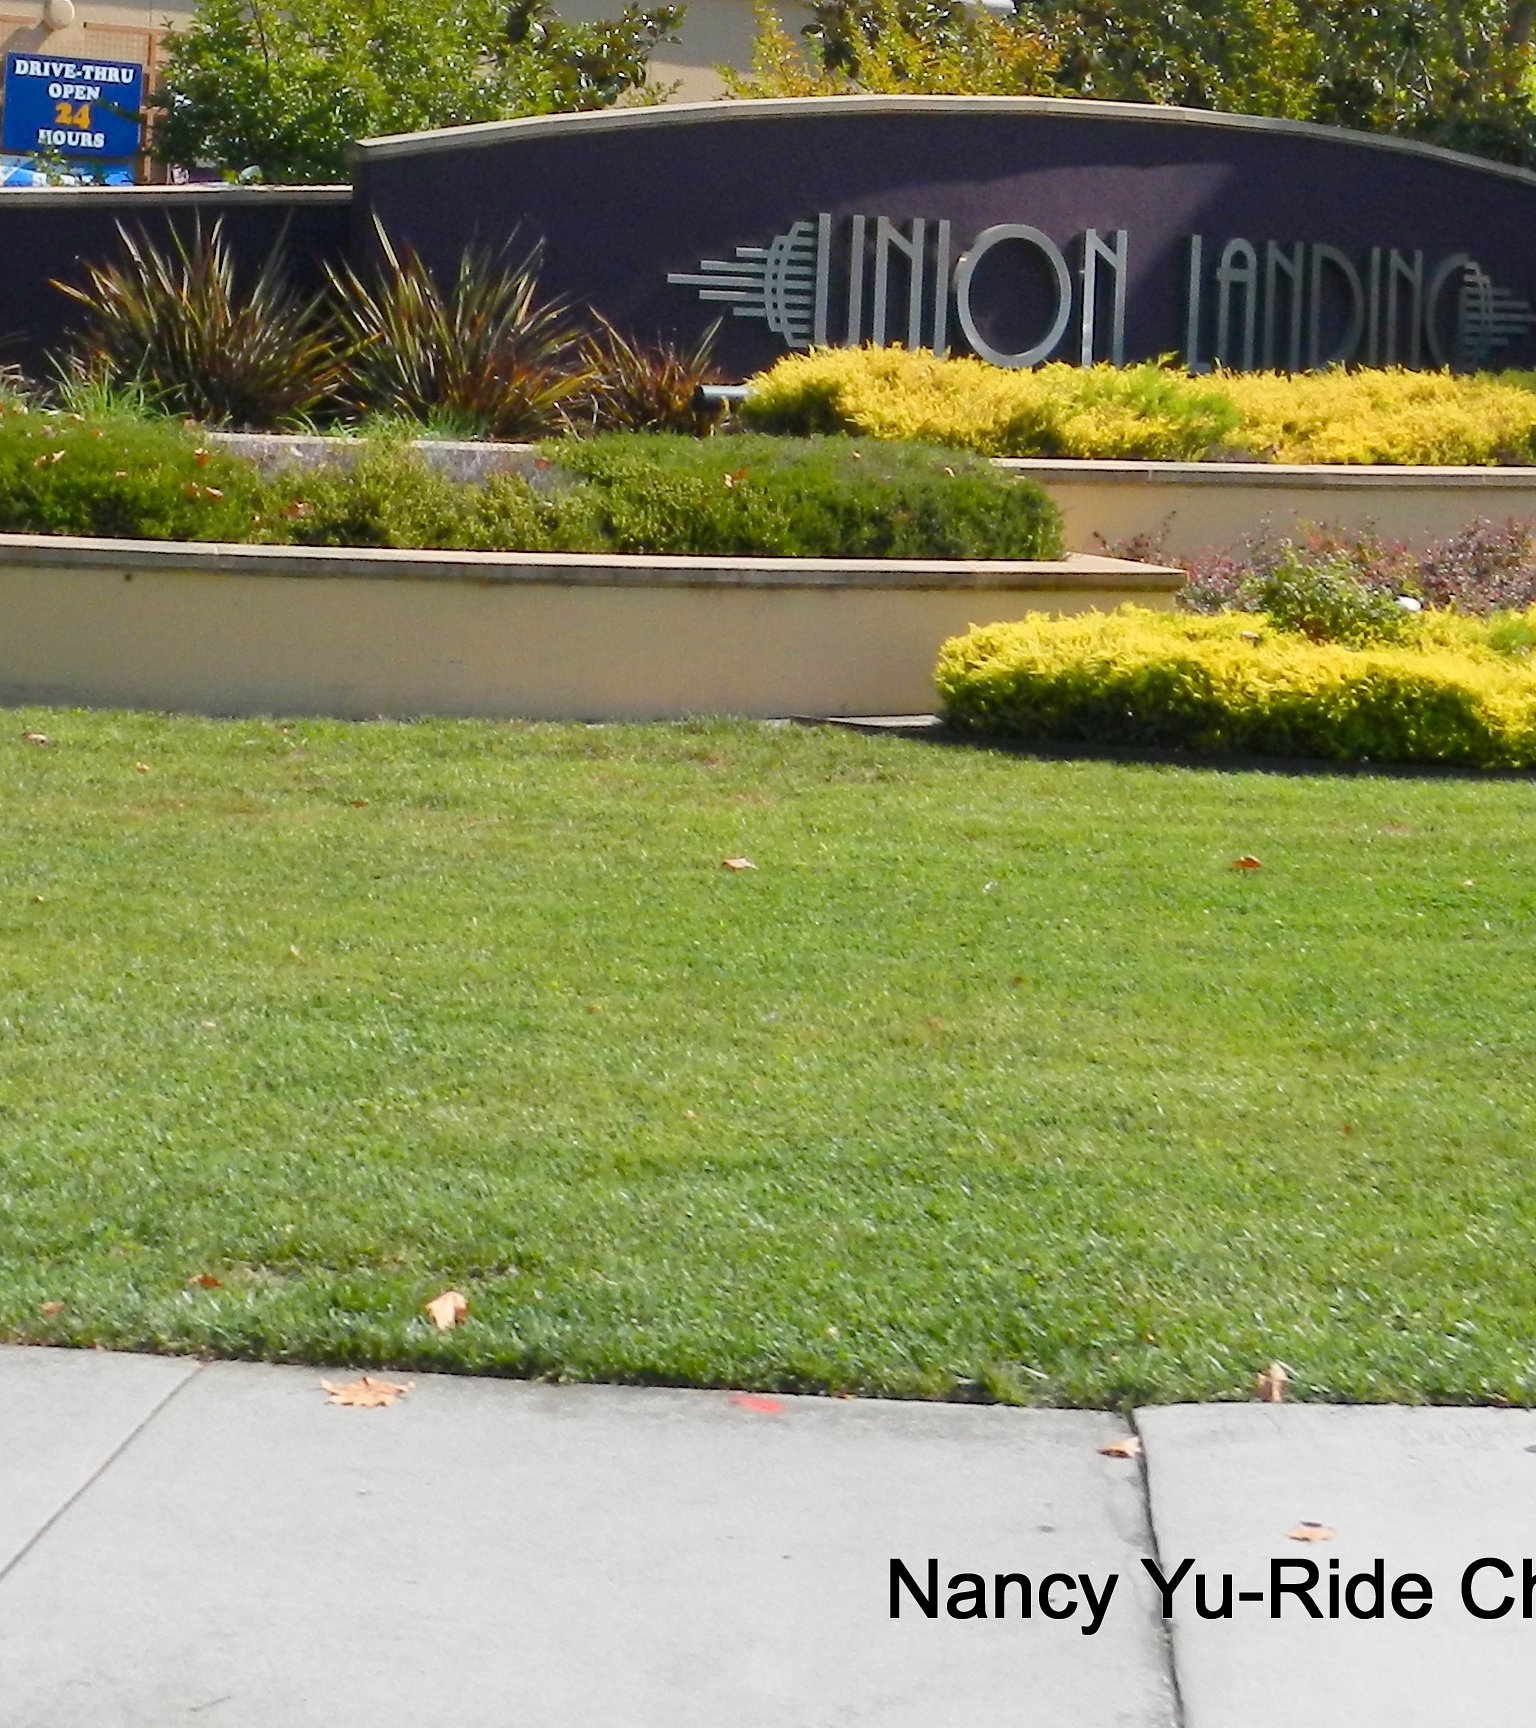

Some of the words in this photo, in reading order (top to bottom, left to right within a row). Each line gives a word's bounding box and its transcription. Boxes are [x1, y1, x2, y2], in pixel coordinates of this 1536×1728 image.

[14, 59, 135, 84] DRIVE-THRU
[48, 83, 102, 102] OPEN
[54, 103, 92, 130] 24
[37, 128, 106, 149] HOURS
[813, 212, 1129, 370] UNION
[1186, 234, 1476, 376] LANDING
